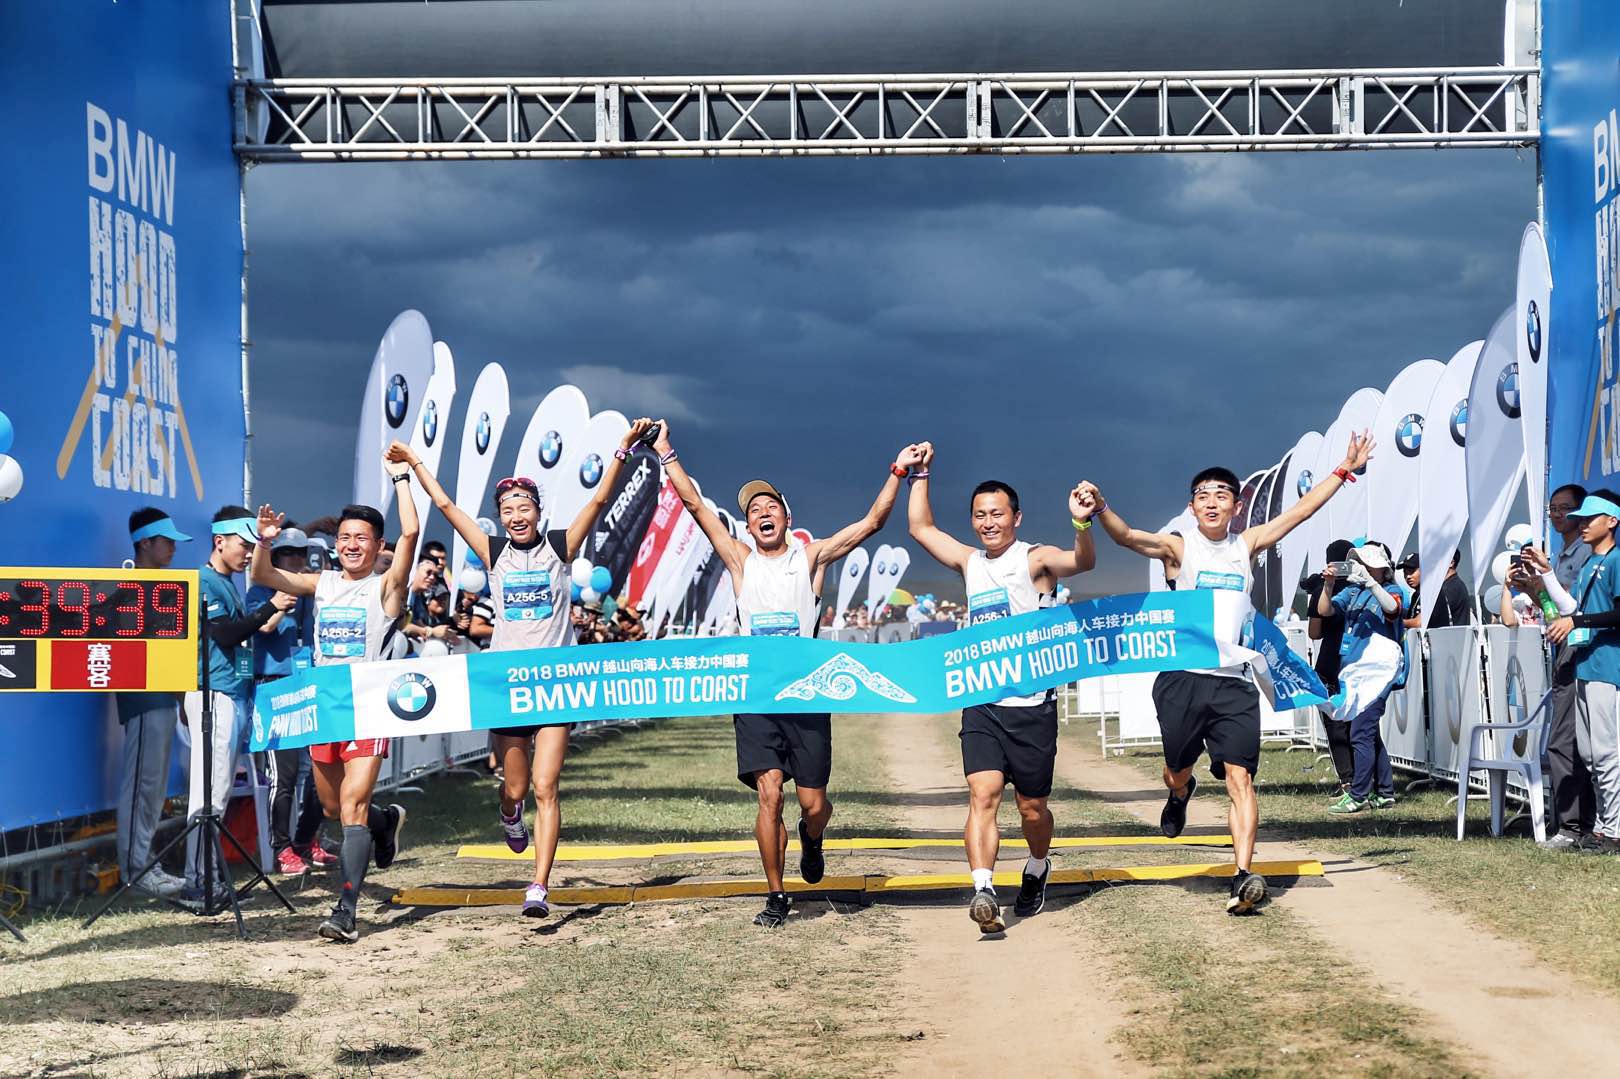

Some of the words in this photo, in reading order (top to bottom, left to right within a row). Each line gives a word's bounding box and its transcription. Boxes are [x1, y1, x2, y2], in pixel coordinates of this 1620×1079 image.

[86, 101, 176, 226] BMW
[88, 196, 177, 344] HOOD
[91, 323, 116, 389] TO
[127, 334, 178, 407] CHINA
[91, 393, 178, 499] COAST
[604, 457, 651, 530] TERREX
[506, 591, 548, 603] A256-5
[972, 609, 1008, 626] A256-1
[321, 627, 363, 639] A256-2
[944, 644, 979, 667] 2018
[981, 632, 1024, 655] BMW
[1026, 608, 1175, 646] 越山向海人车接力中国赛
[944, 654, 1023, 699] BMW
[1028, 641, 1079, 680] HOOD
[1083, 636, 1109, 665] TO
[1116, 630, 1176, 660] COAST
[507, 664, 552, 683] 2018
[556, 660, 600, 679] BMW
[602, 653, 749, 675] 越山向海人车接力中国赛
[509, 681, 597, 714] BMW
[602, 677, 656, 706] HOOD
[662, 677, 685, 704] TO
[690, 674, 749, 703] COAST
